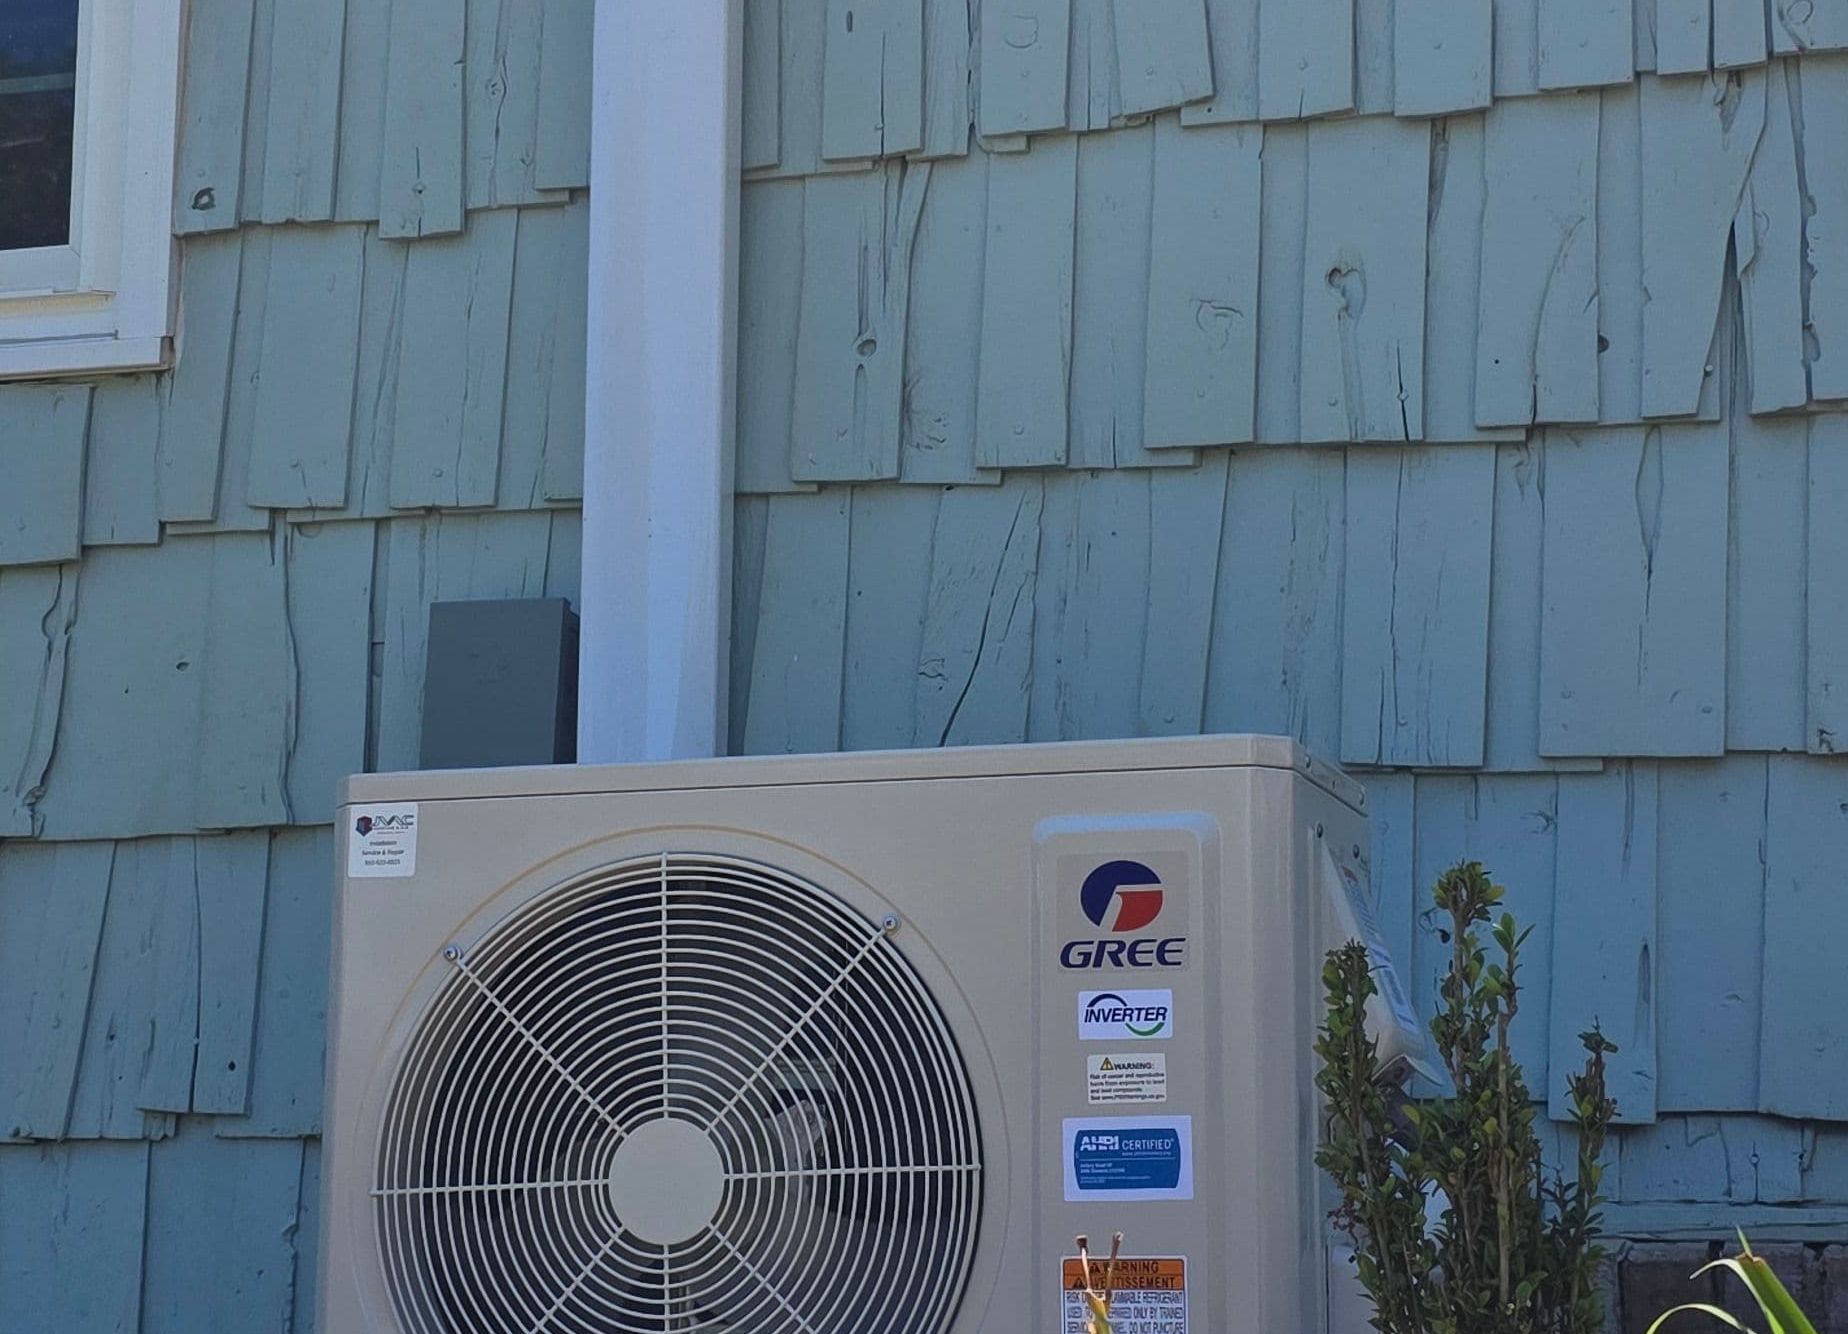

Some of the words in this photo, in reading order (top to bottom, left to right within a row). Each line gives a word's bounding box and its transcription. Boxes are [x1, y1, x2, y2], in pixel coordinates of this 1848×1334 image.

[1060, 938, 1187, 968] GREE
[1084, 1007, 1168, 1022] INVERTER
[1080, 1135, 1120, 1151] AHRI
[1087, 1276, 1175, 1289] VETISSEMENT
